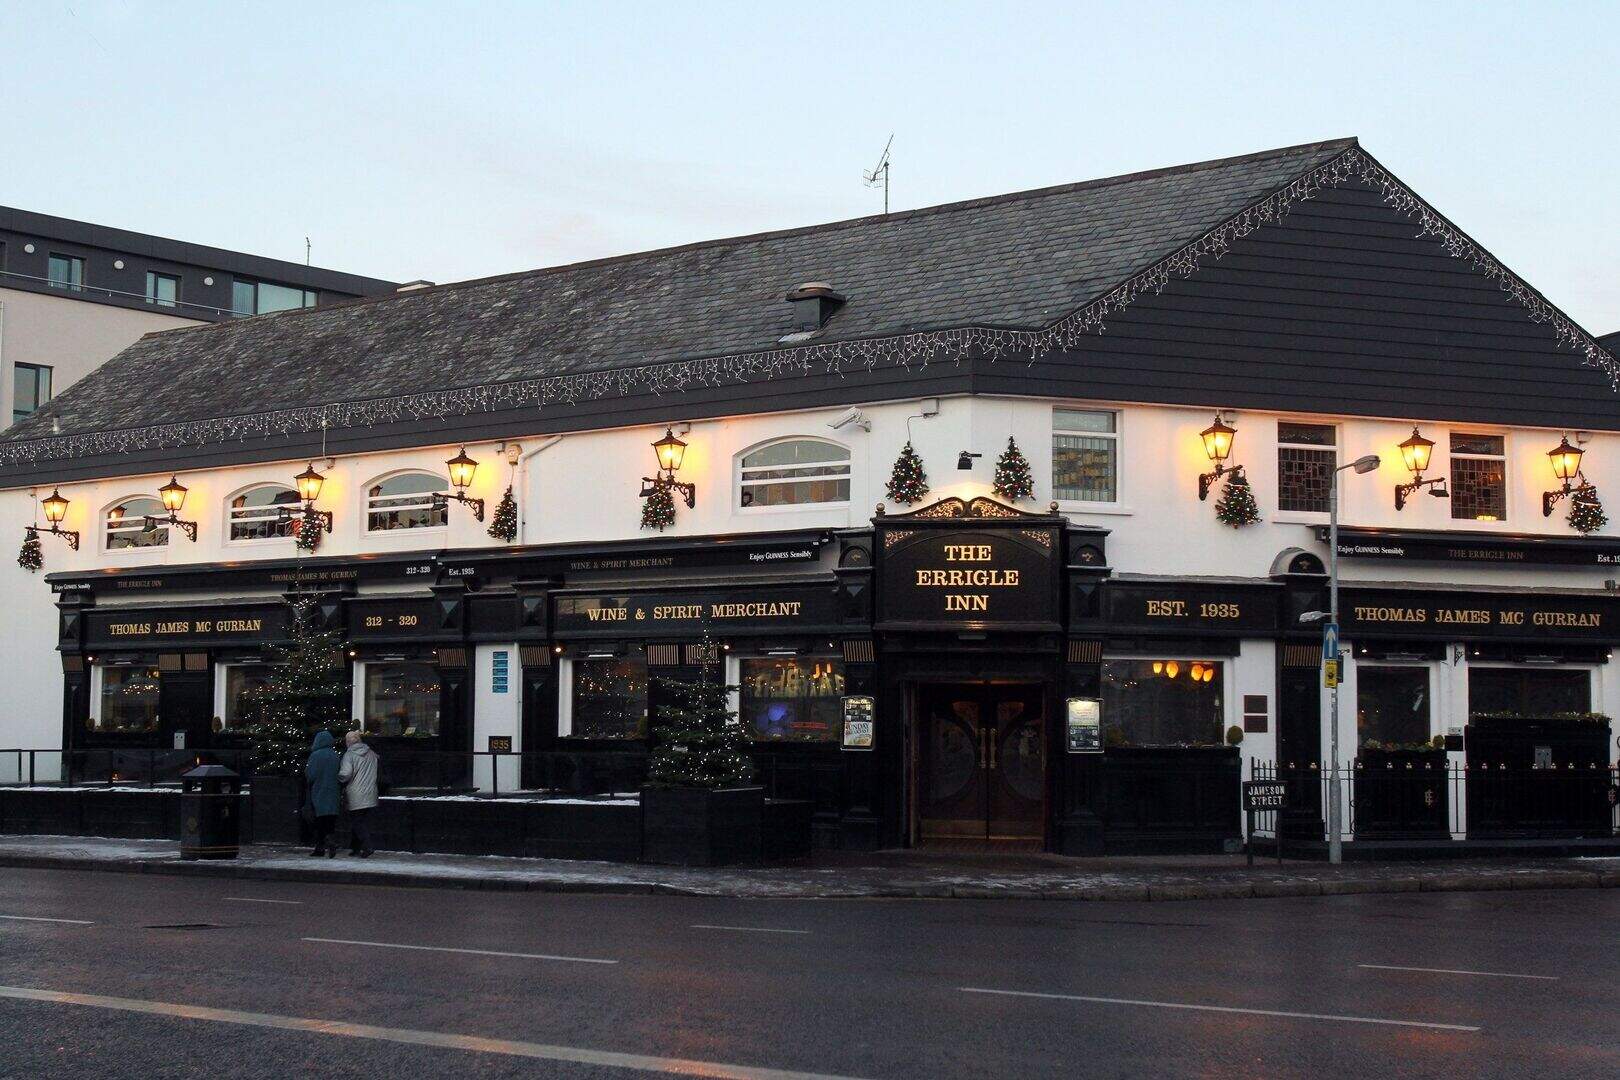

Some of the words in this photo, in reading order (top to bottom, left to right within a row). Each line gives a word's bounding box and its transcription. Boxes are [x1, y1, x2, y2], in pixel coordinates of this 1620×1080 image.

[944, 545, 992, 561] THE
[1448, 550, 1466, 558] THE
[1468, 551, 1504, 559] ERRIGLE
[1507, 552, 1524, 560] INN
[570, 562, 591, 570] WINE
[601, 559, 628, 569] SPIRIT
[629, 557, 674, 568] MERCHANT
[916, 570, 1019, 586] ERRIGLE
[587, 607, 627, 622] WINE
[635, 608, 645, 621] &
[653, 604, 702, 620] SPIRIT
[711, 600, 801, 618] MERCHANT
[945, 595, 989, 611] INN
[1147, 600, 1188, 616] EST.
[1200, 603, 1240, 618] 1935
[366, 616, 382, 627] 312
[399, 616, 417, 626] 320
[1355, 607, 1426, 623] THOMAS
[1435, 609, 1490, 625] JAMES
[1500, 611, 1524, 625] MC
[1532, 611, 1601, 627] GURRAN
[110, 623, 151, 635] THOMAS
[155, 622, 189, 633] JAMES
[196, 621, 211, 633] MC
[216, 619, 262, 632] GURRAN
[1248, 785, 1285, 795] JAMESON
[1251, 796, 1282, 806] STREET
